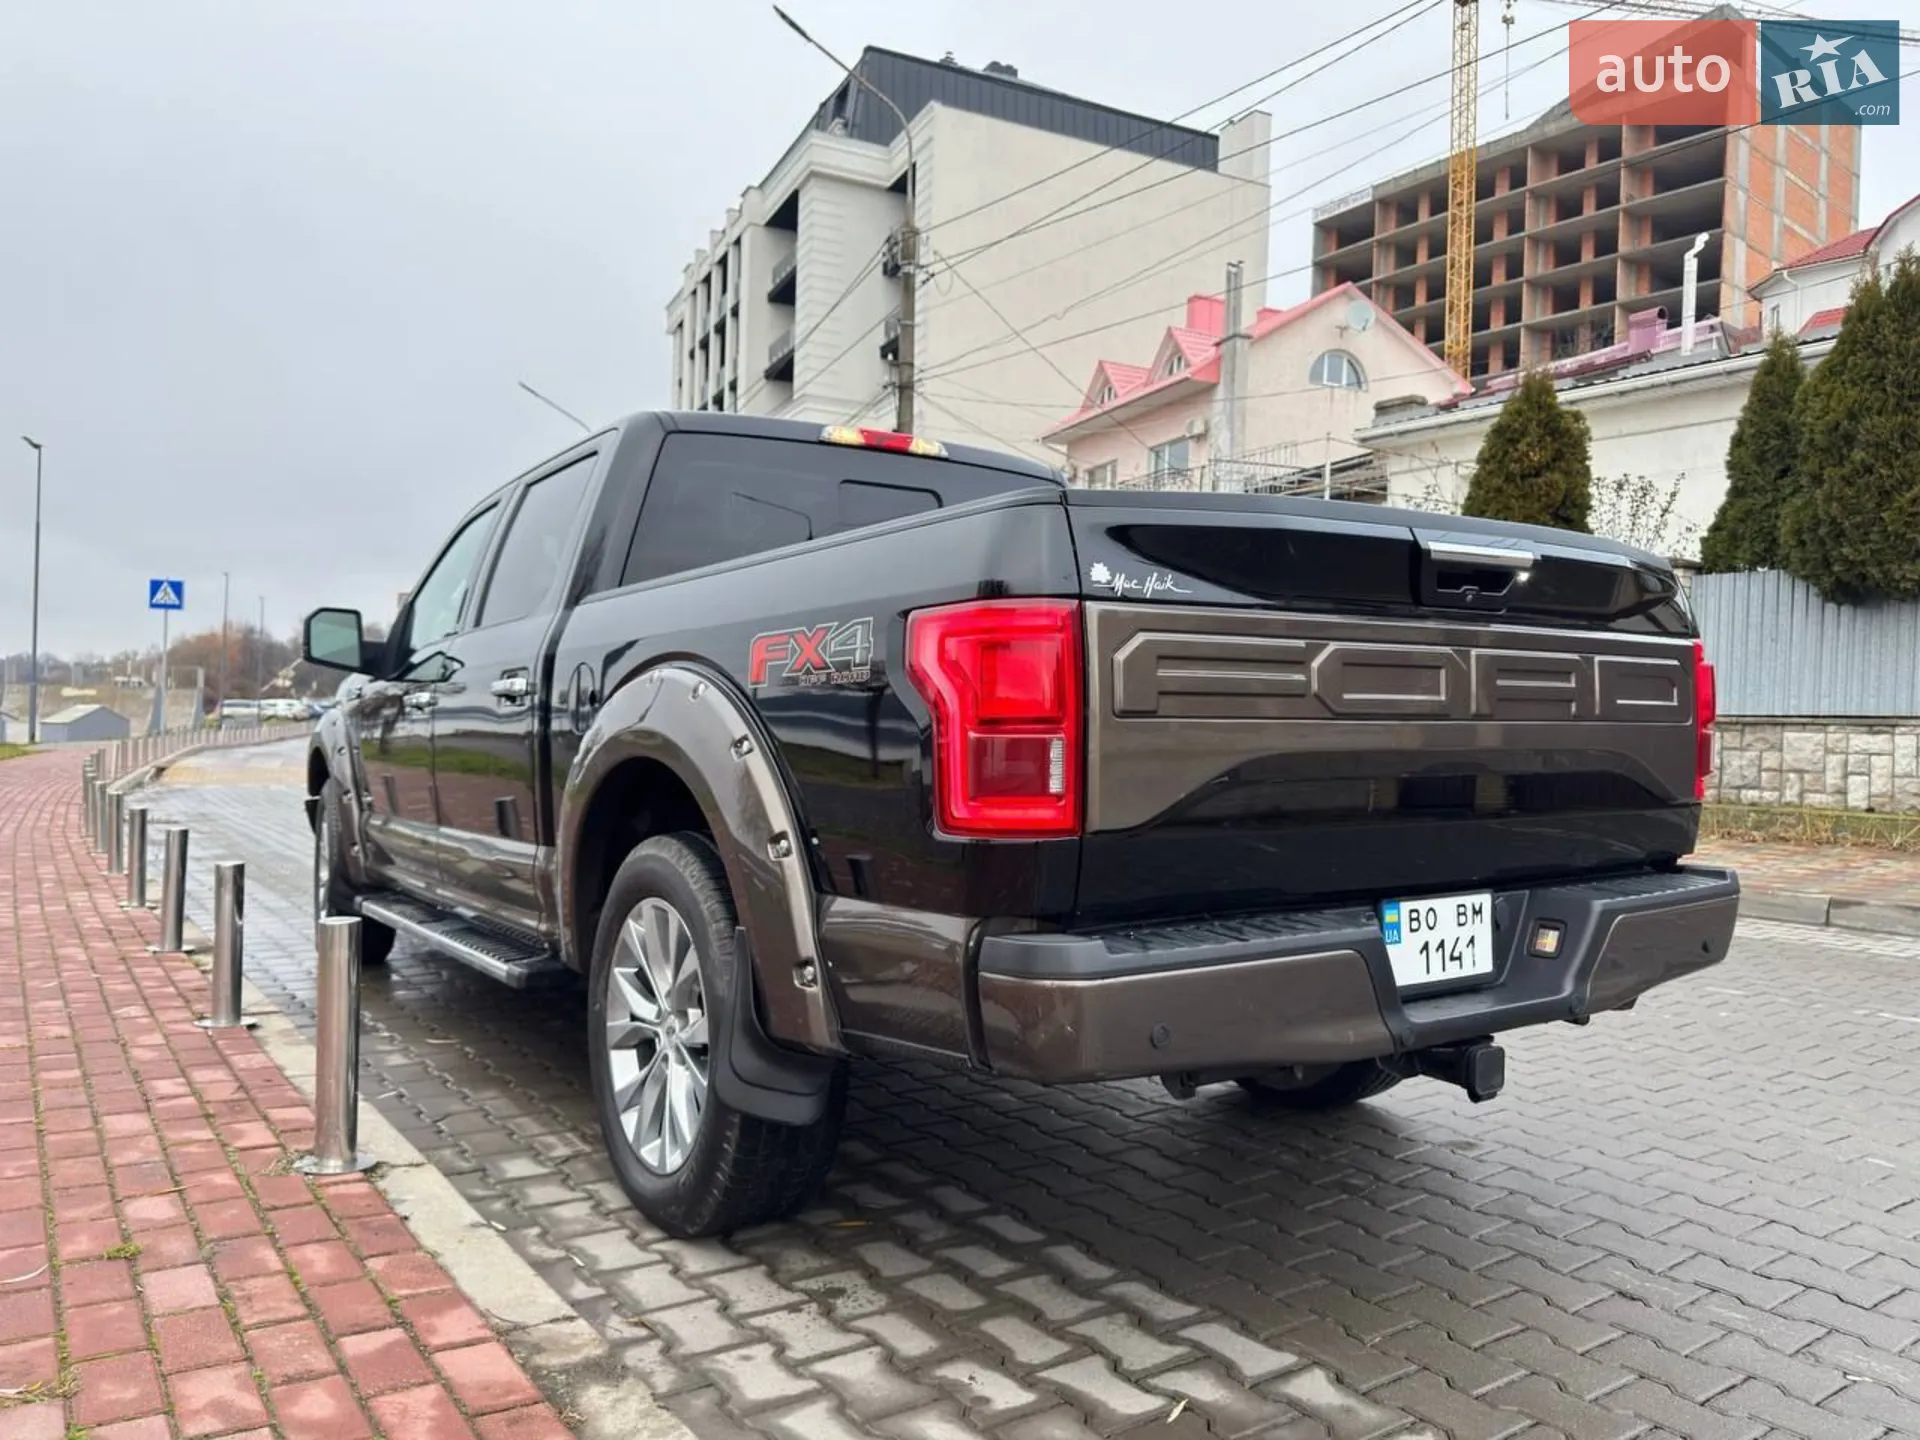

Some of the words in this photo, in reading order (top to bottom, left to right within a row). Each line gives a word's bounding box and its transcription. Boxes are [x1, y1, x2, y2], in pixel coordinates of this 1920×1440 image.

[748, 616, 873, 688] FX4
[1112, 631, 1693, 722] FORD
[1385, 929, 1400, 943] UA
[1408, 907, 1437, 932] BO
[1456, 902, 1483, 927] BM
[1419, 935, 1475, 975] 1141
